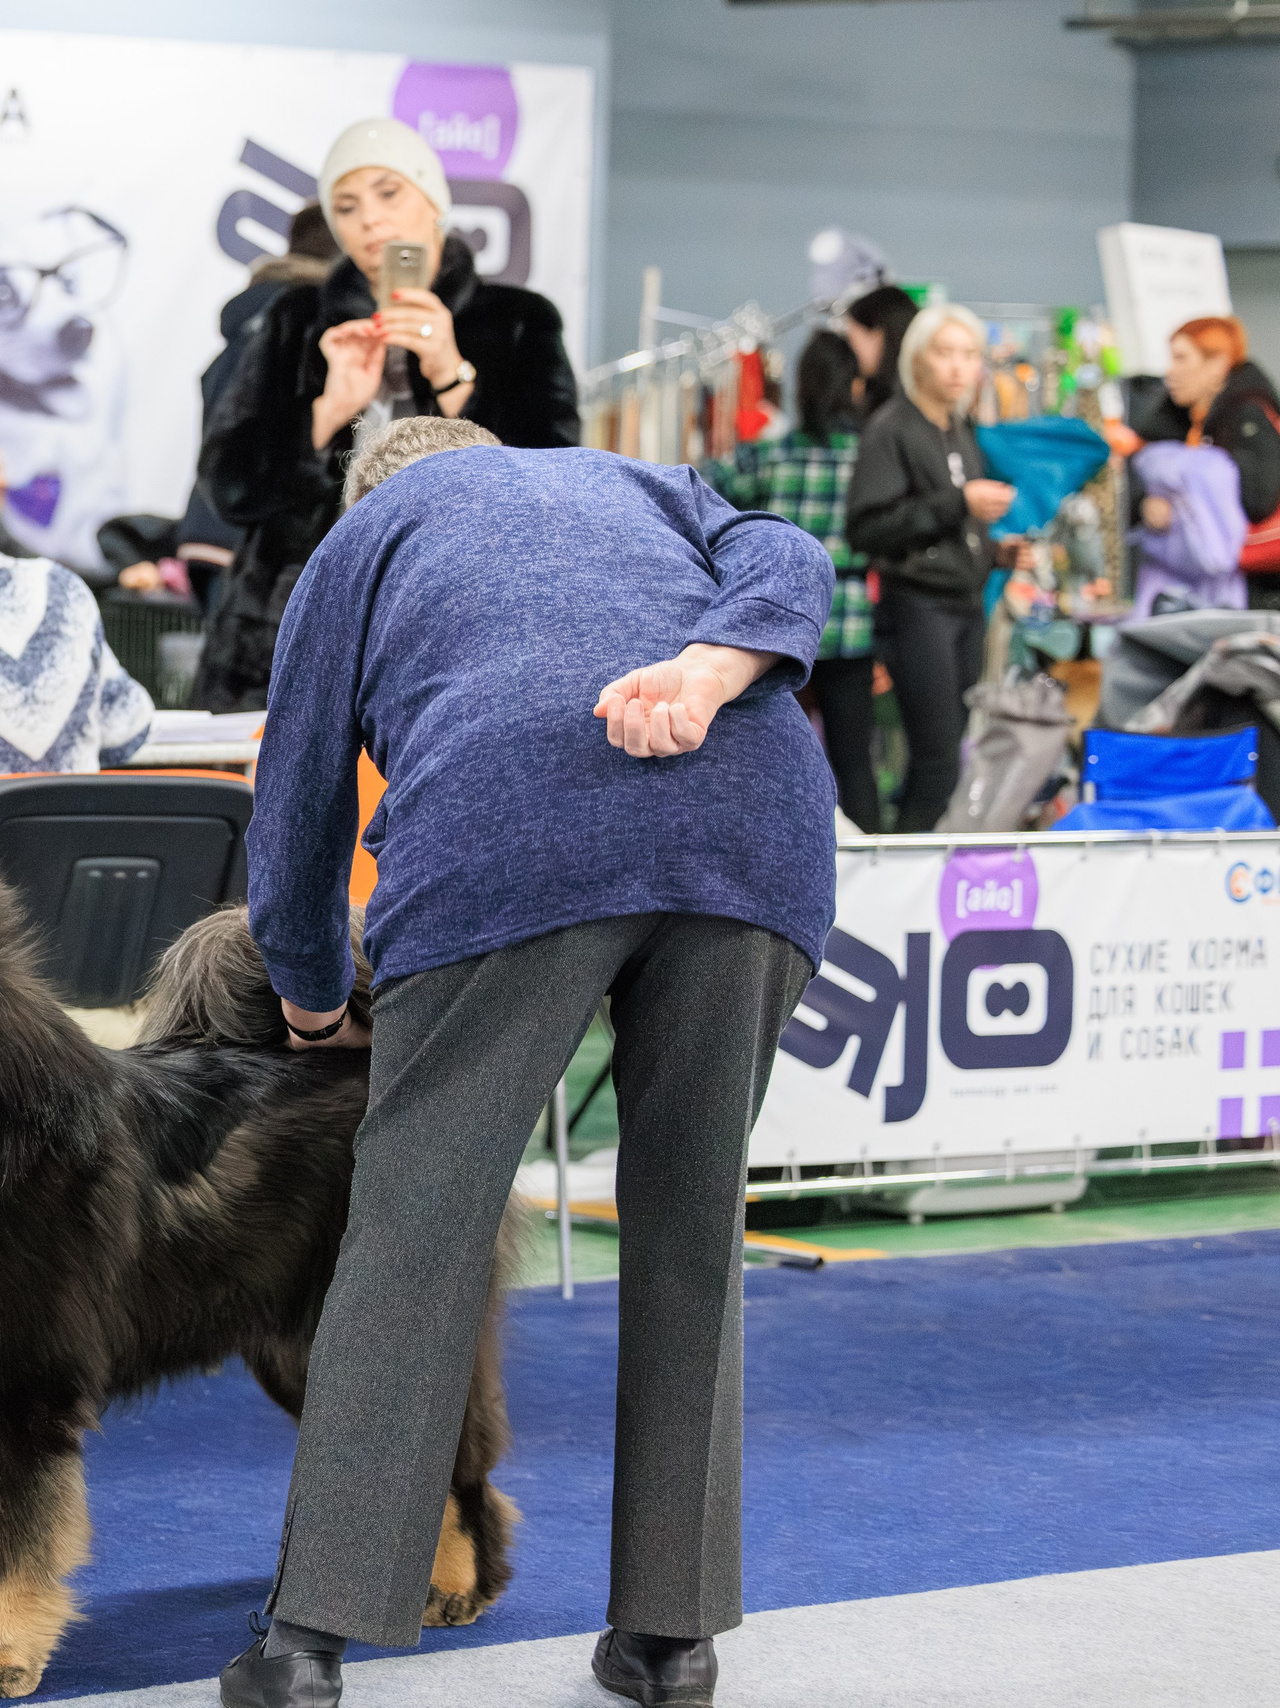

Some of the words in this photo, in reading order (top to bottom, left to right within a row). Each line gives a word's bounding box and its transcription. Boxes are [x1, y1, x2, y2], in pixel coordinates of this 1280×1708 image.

[1225, 861, 1280, 904] СФ
[1089, 940, 1170, 976] СУХИЕ
[1188, 937, 1269, 971] КОРМА
[1087, 984, 1137, 1022] ДЛЯ
[1154, 980, 1236, 1017] КОШЕК
[1087, 1030, 1104, 1062] И
[1121, 1025, 1202, 1061] СОБАК
